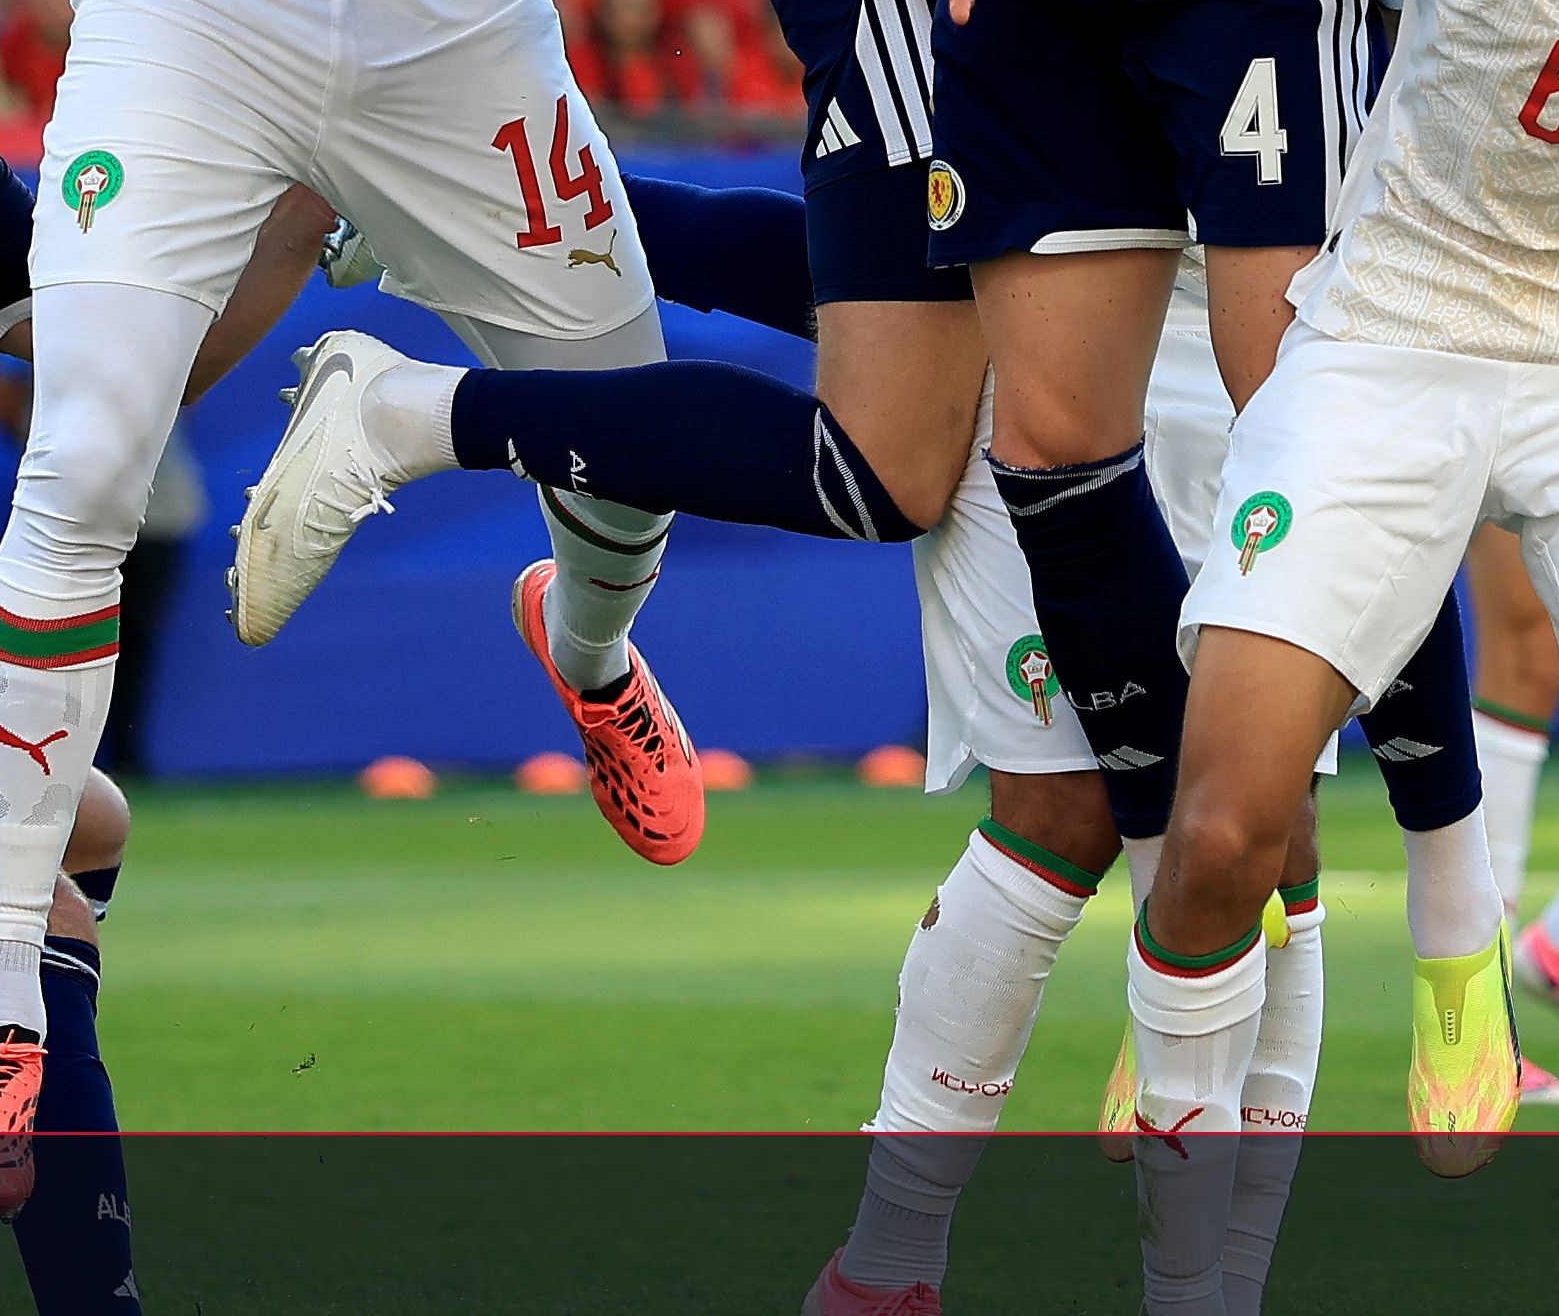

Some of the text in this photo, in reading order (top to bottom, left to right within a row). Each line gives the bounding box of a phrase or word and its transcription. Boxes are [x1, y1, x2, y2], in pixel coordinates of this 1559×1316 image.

[491, 94, 613, 250] 14
[1219, 57, 1287, 186] 4
[97, 1193, 132, 1229] ALB
